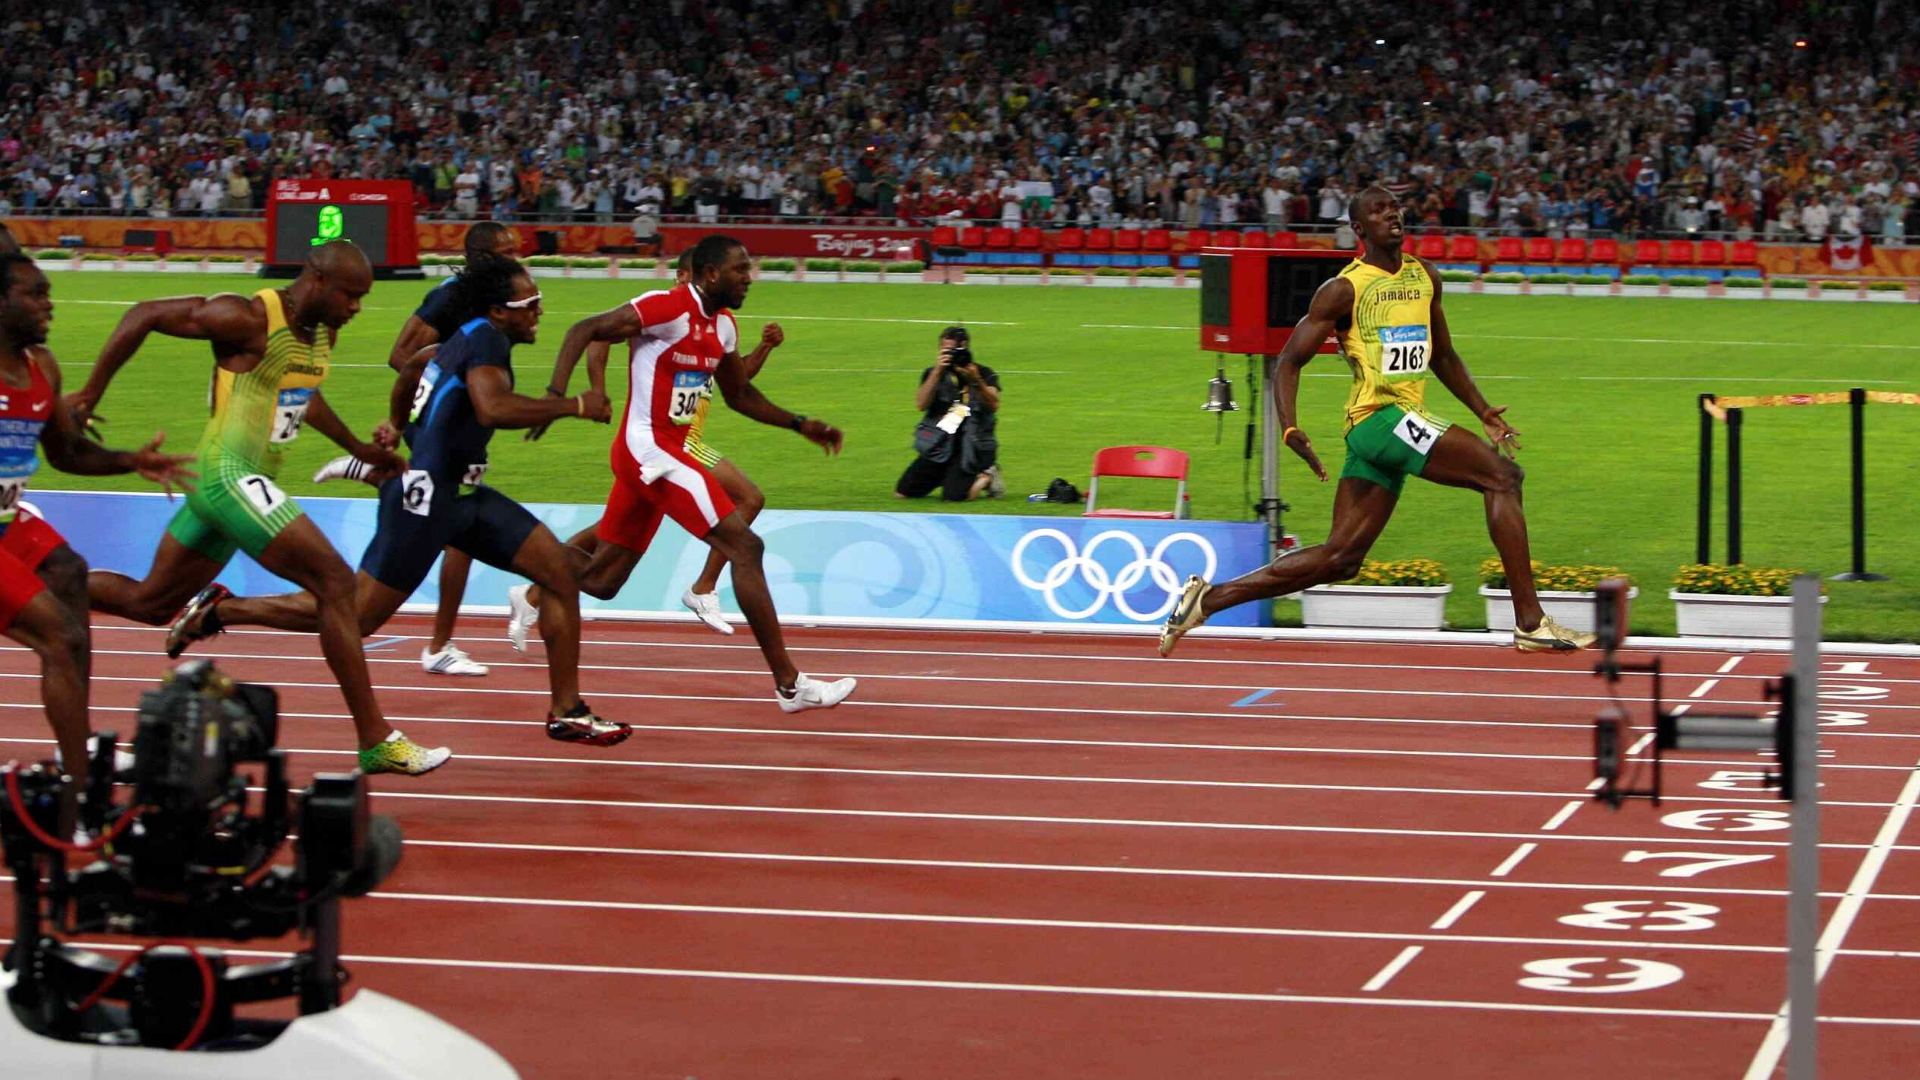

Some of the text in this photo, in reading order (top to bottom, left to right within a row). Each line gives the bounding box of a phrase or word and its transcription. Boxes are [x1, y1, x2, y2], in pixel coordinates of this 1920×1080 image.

[318, 187, 331, 200] A
[810, 234, 875, 257] Beijing
[1374, 287, 1420, 305] jamaica
[1388, 345, 1425, 371] 2163
[1406, 418, 1431, 445] 4
[246, 477, 273, 506] 7
[404, 474, 426, 510] 6
[1817, 661, 1882, 675] 1
[1659, 809, 1791, 832] 6
[1621, 850, 1776, 878] 7
[1557, 900, 1721, 932] 8
[1516, 957, 1685, 994] 9
